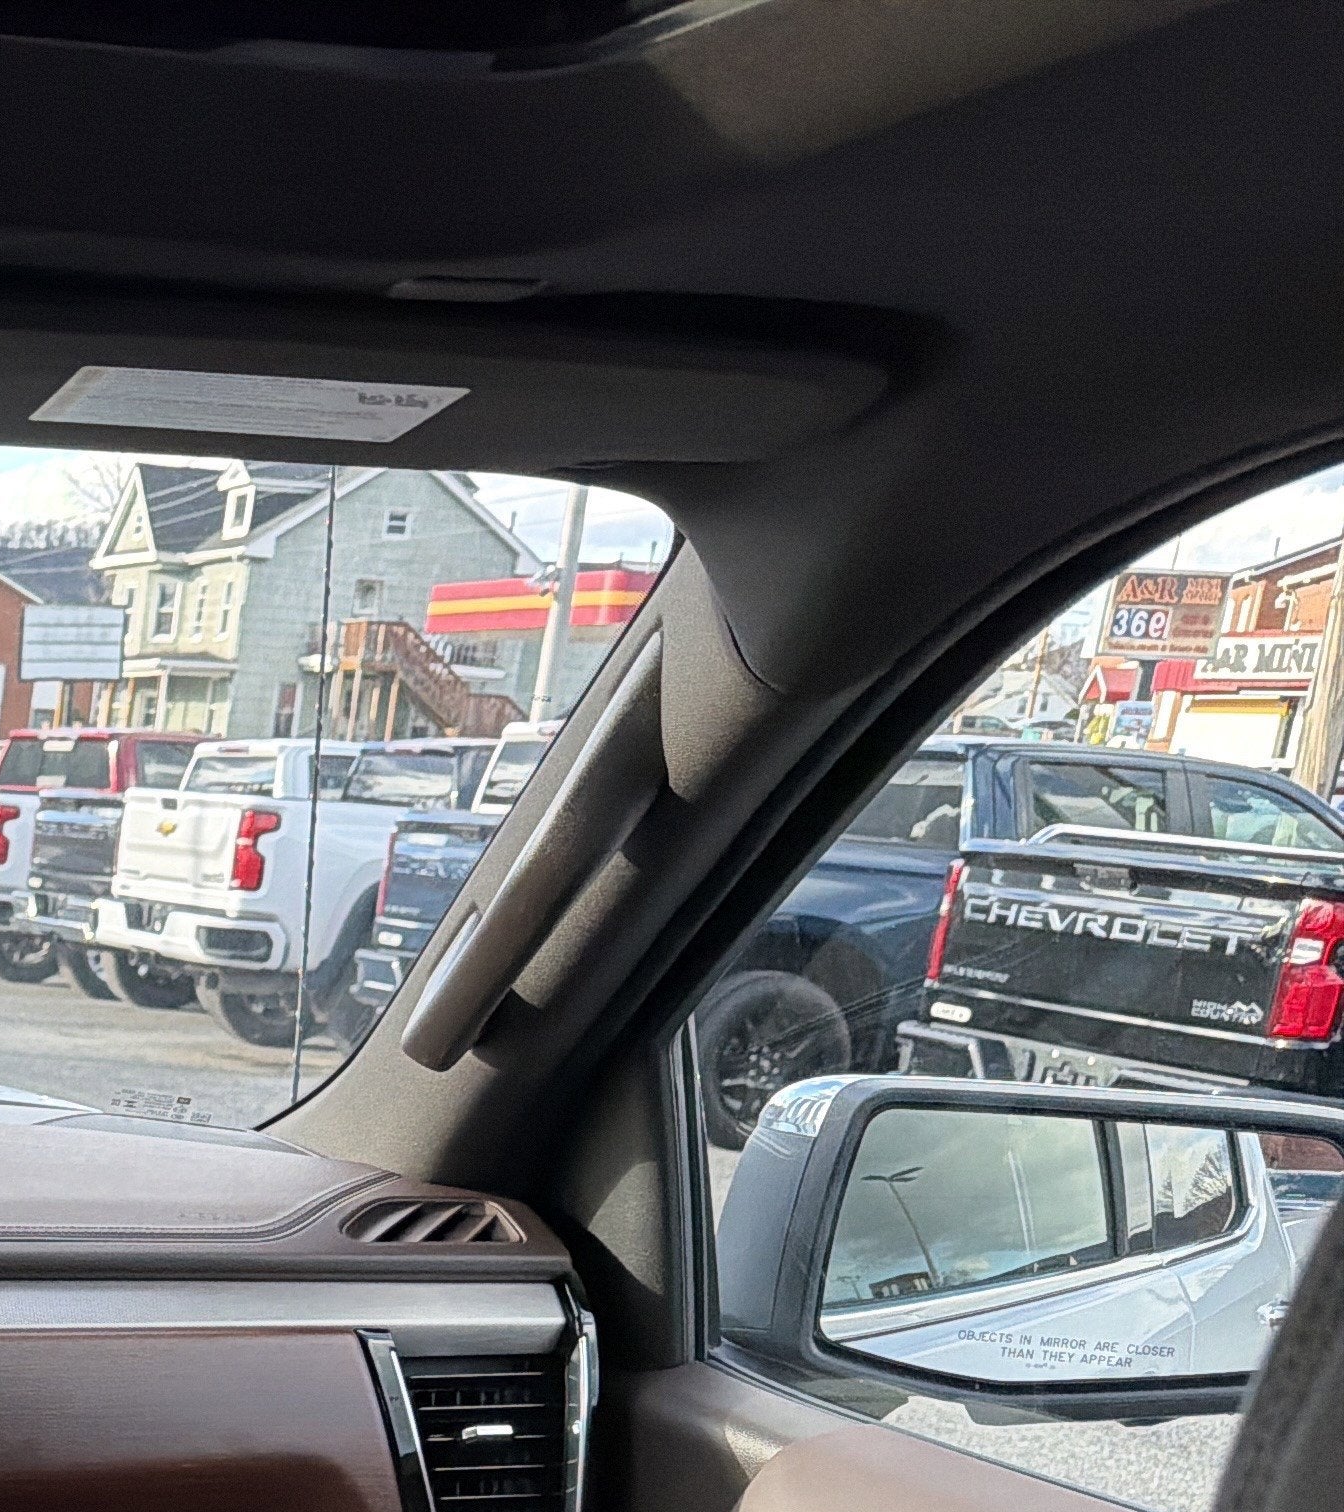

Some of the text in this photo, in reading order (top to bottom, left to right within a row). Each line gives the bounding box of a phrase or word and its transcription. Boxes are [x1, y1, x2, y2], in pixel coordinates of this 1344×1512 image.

[1115, 574, 1179, 604] A&R
[964, 894, 1255, 956] CHEVROLET
[958, 1330, 1176, 1358] OBJECTS IN MIRROR ARE CLOSER
[1001, 1347, 1133, 1368] THAN THEY APPEAR
